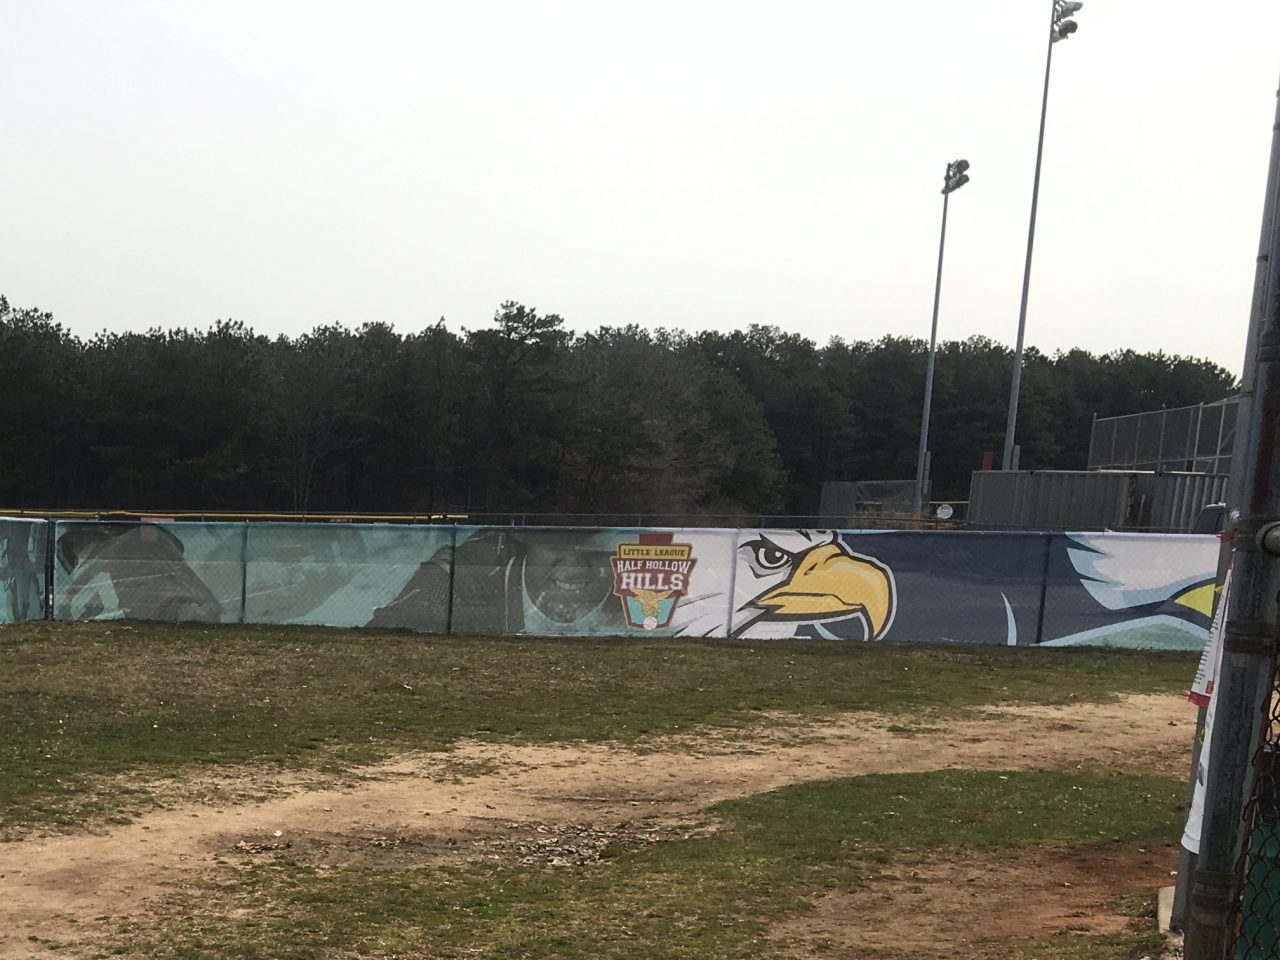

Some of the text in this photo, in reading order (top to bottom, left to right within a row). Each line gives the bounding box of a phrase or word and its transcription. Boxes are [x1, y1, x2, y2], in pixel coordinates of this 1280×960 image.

[623, 548, 685, 557] LITTLE LEAGUE
[617, 560, 691, 574] HALF HOLLOW
[620, 572, 684, 590] HILLS
